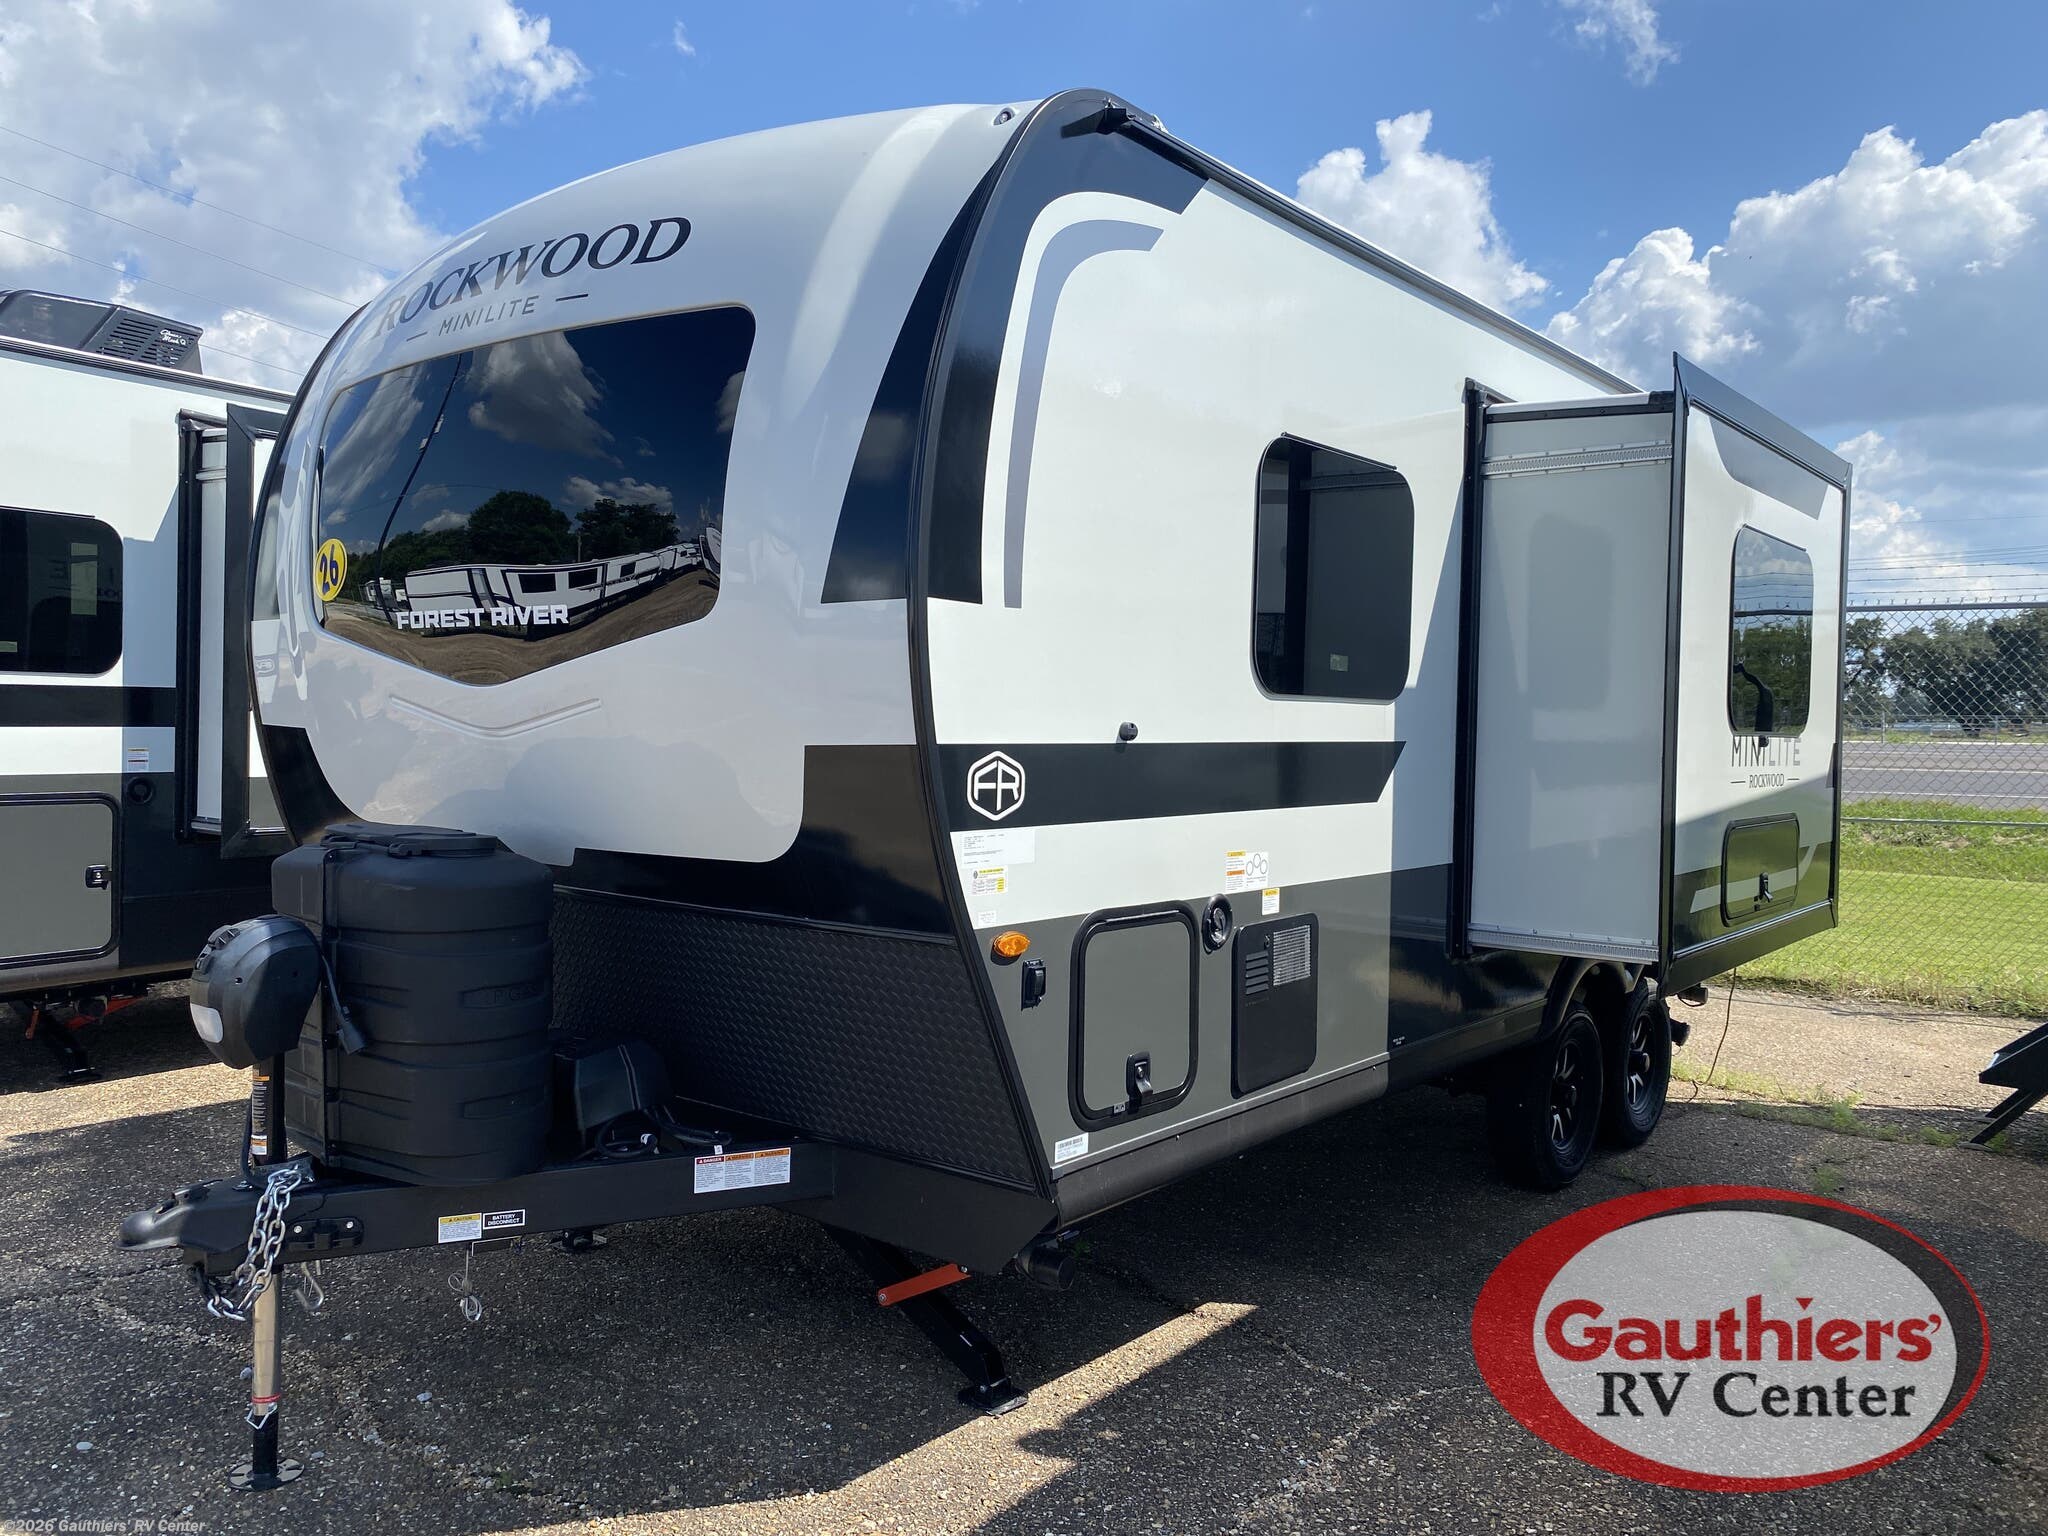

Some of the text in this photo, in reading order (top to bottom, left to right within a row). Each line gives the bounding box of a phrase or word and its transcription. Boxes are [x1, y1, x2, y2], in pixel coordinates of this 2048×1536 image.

[373, 217, 692, 339] ROCKWOOD
[438, 295, 540, 336] MINILITE
[319, 543, 338, 593] 26
[396, 604, 569, 630] FOREST RIVER
[1731, 735, 1801, 767] MINILITE
[1749, 773, 1785, 789] ROCKWOOD
[487, 1218, 520, 1226] DISCONNECT
